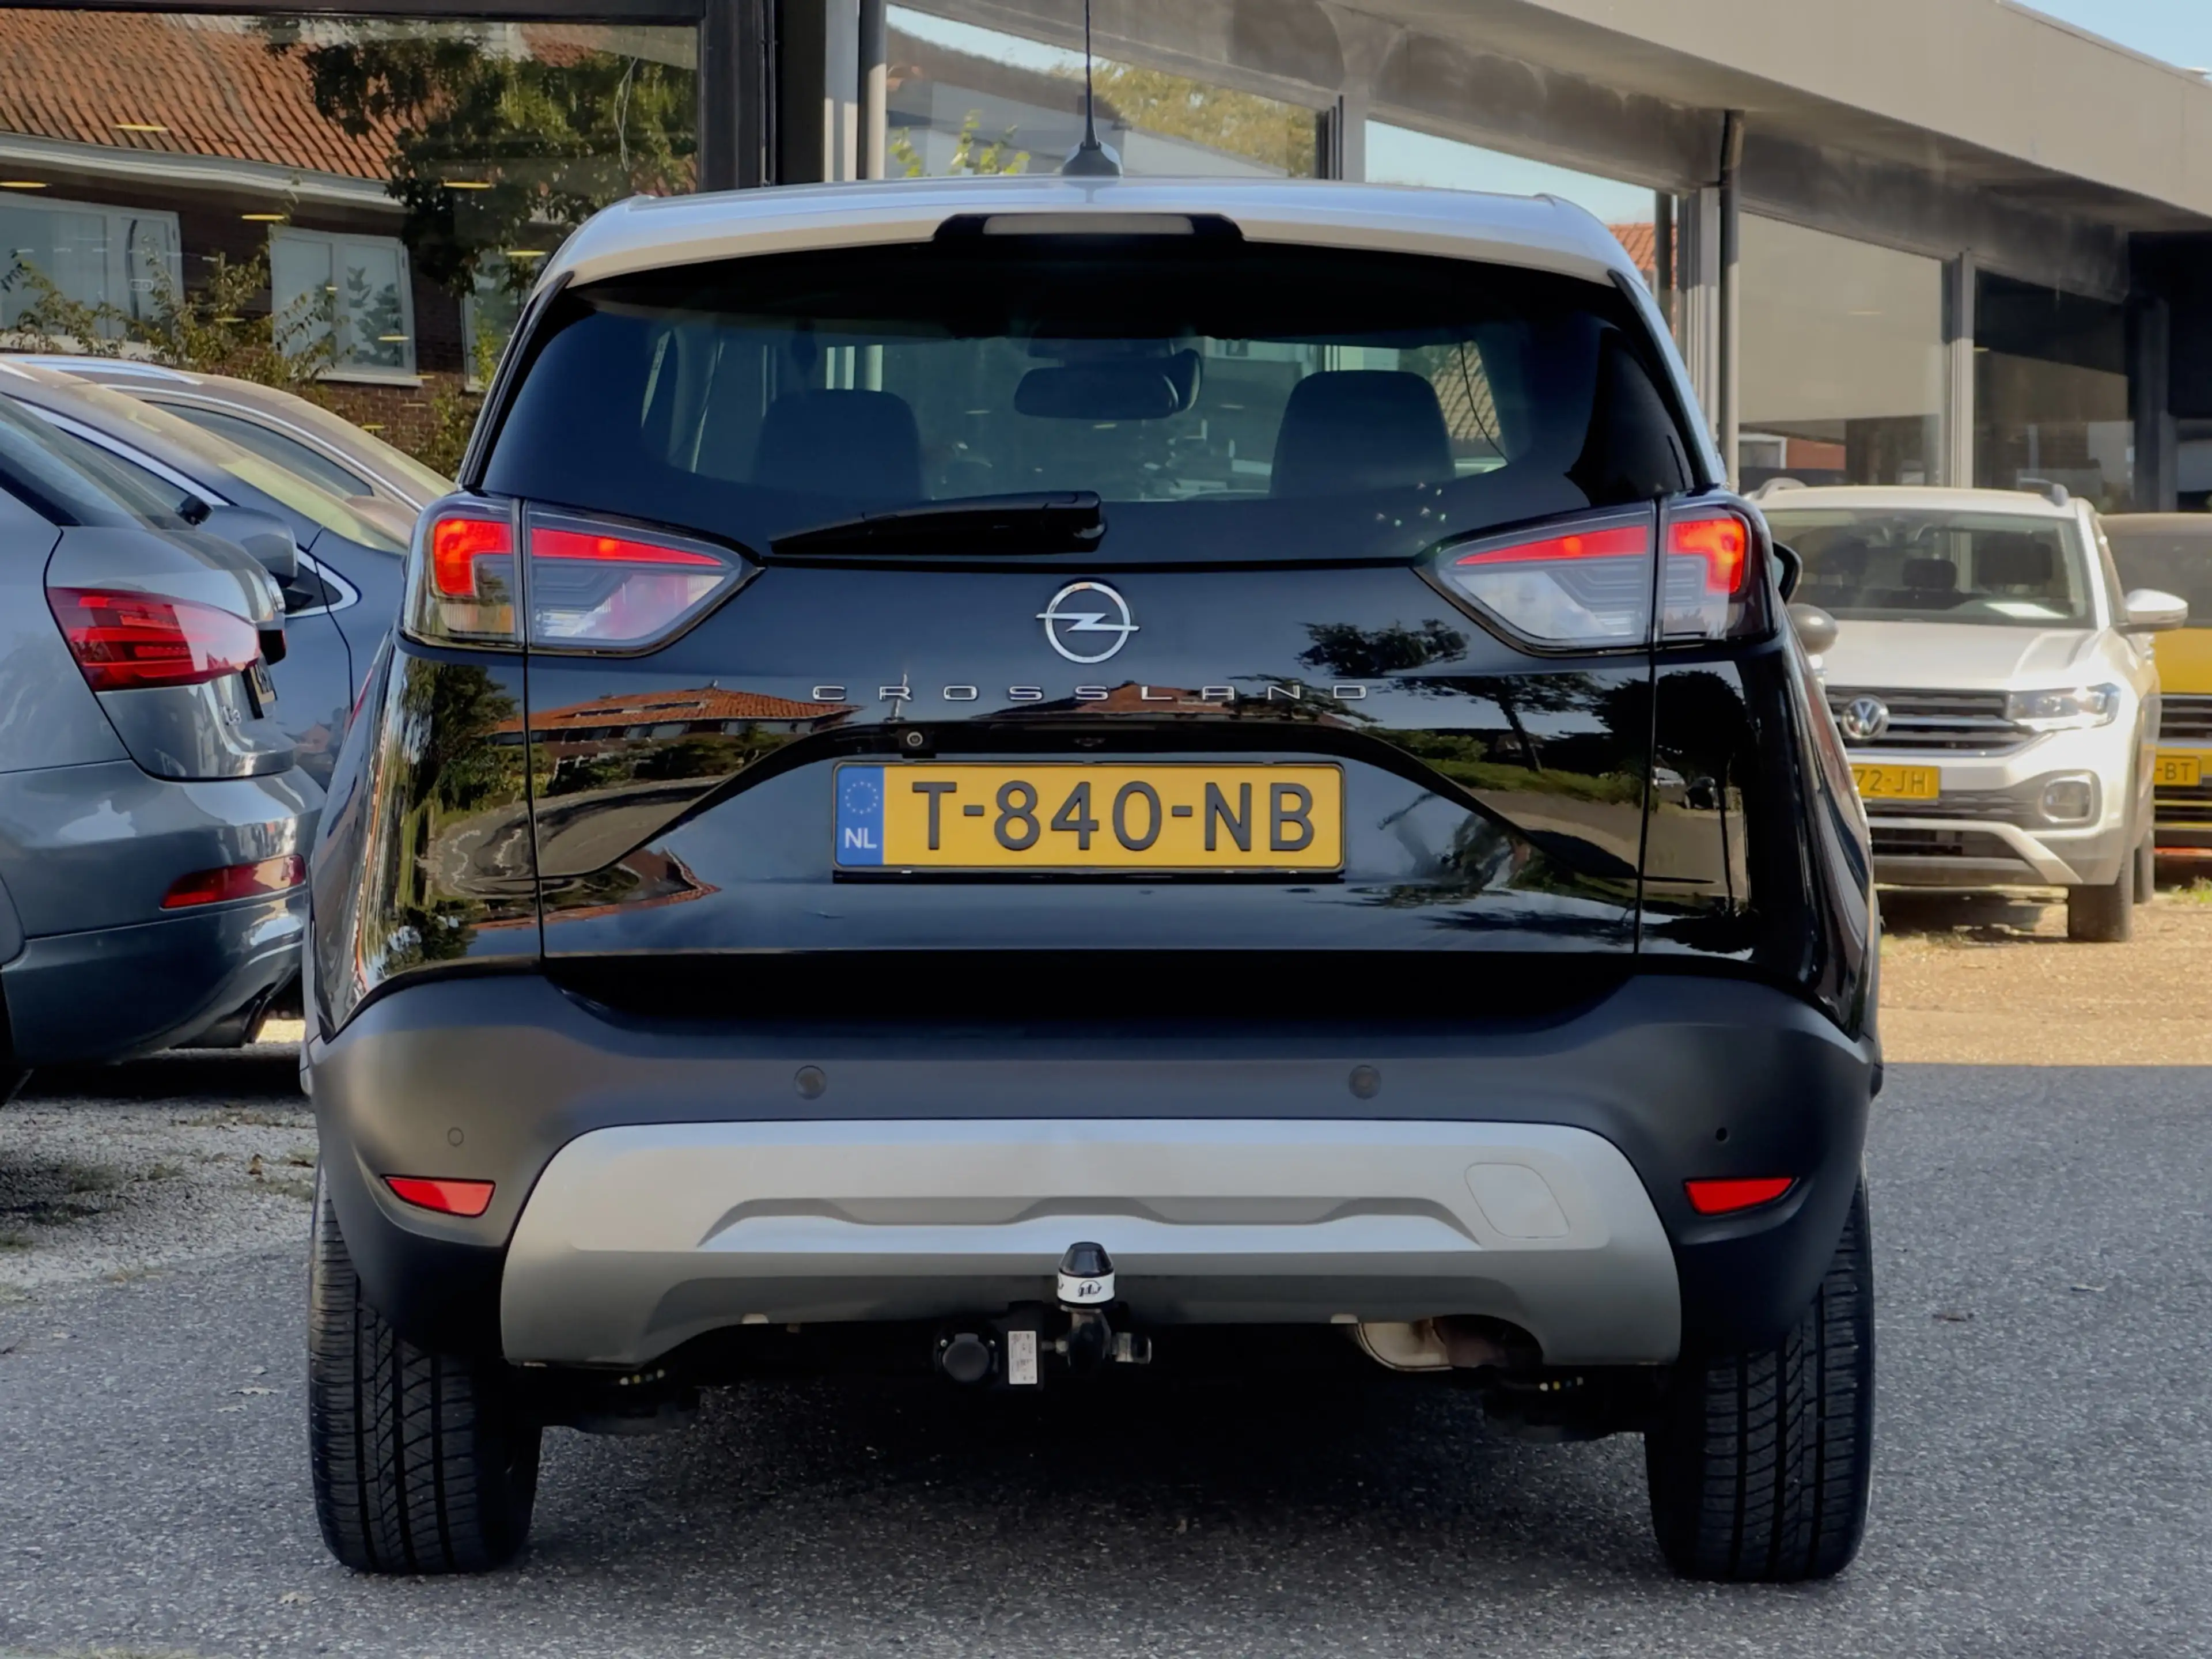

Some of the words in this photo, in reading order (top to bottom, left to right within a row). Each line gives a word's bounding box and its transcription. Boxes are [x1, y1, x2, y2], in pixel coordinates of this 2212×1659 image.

[812, 685, 1367, 701] CROSSLAND
[912, 780, 1315, 851] T-840-NB
[844, 828, 877, 849] NL
